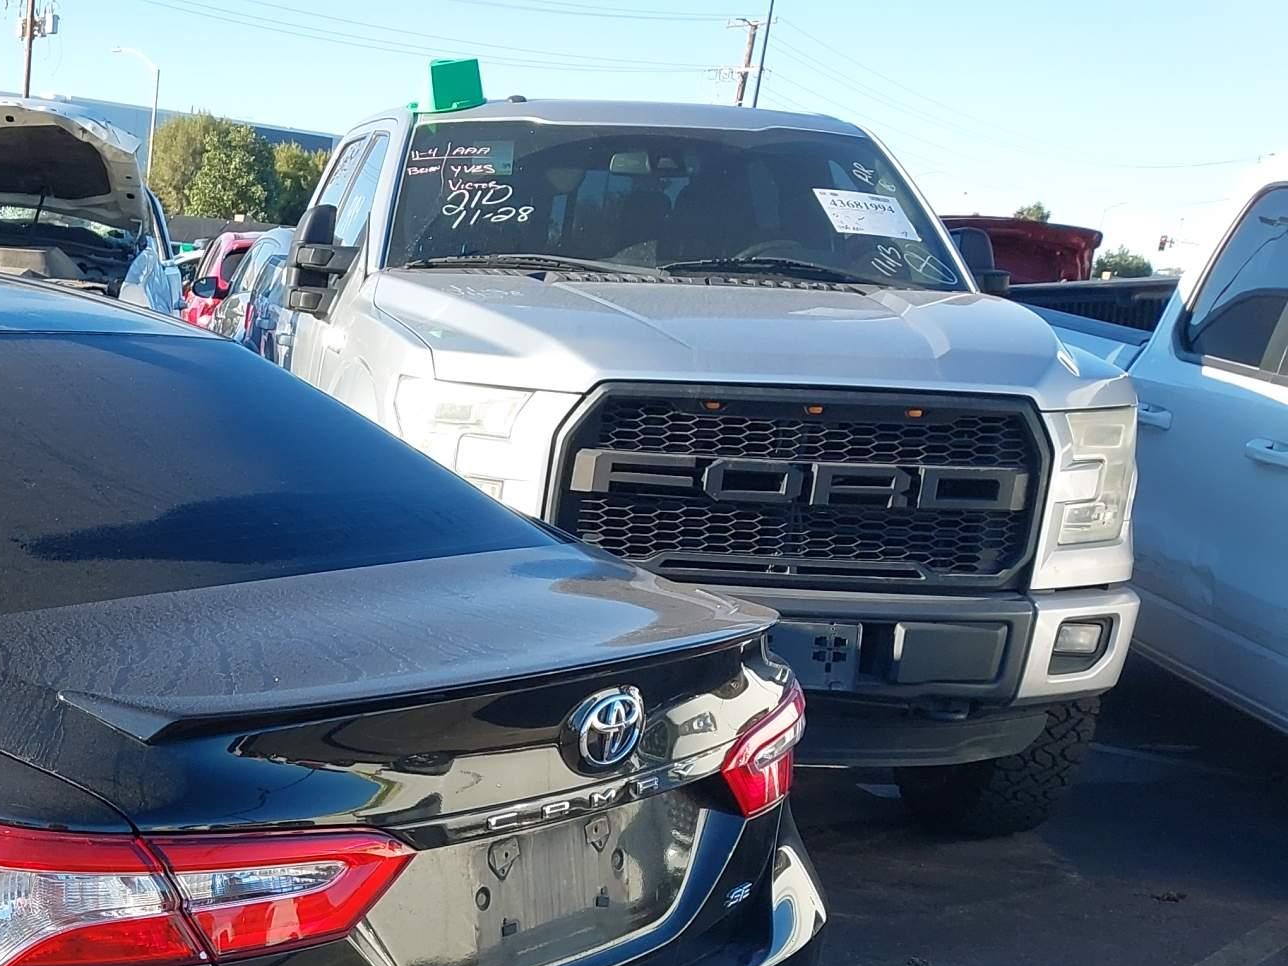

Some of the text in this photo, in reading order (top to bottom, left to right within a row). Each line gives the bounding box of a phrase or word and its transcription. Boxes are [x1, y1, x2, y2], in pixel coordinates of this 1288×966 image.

[828, 197, 896, 214] 43681994
[570, 448, 1028, 511] FORD
[487, 762, 697, 831] CAMRY
[725, 881, 753, 908] SE
